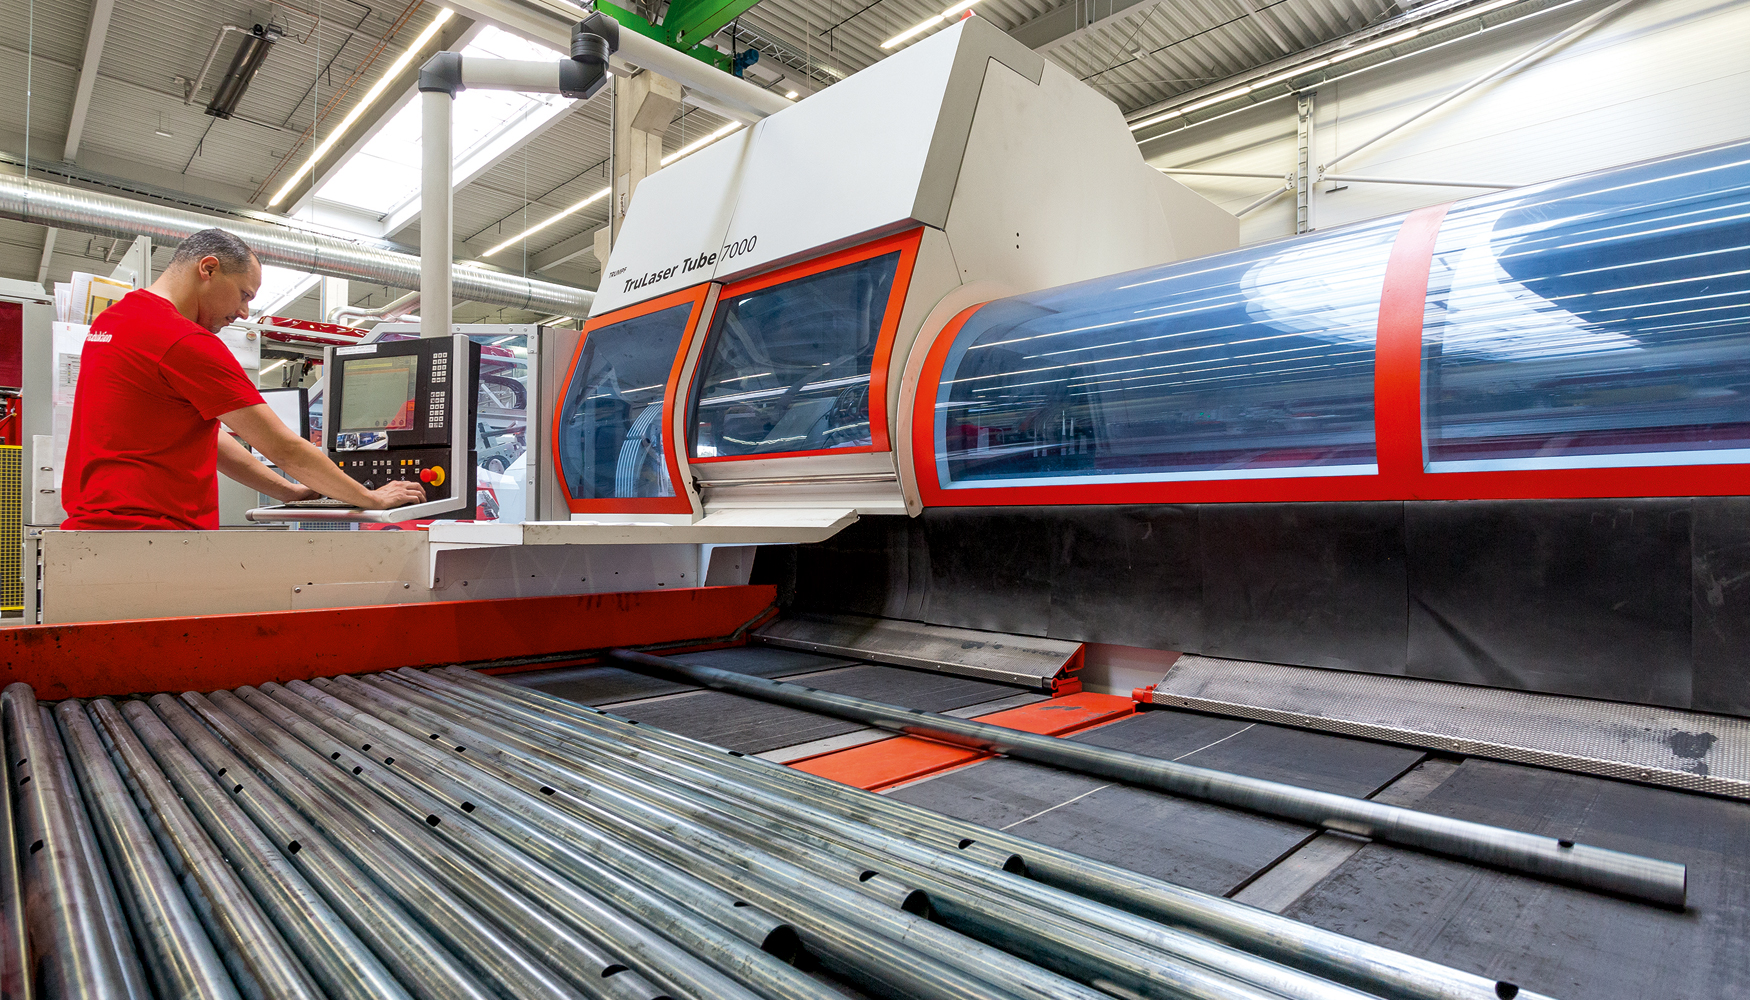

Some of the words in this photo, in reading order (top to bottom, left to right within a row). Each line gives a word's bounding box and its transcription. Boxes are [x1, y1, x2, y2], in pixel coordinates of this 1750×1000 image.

[623, 265, 679, 293] TruLaser
[680, 252, 717, 274] Tube
[721, 235, 757, 262] 7000
